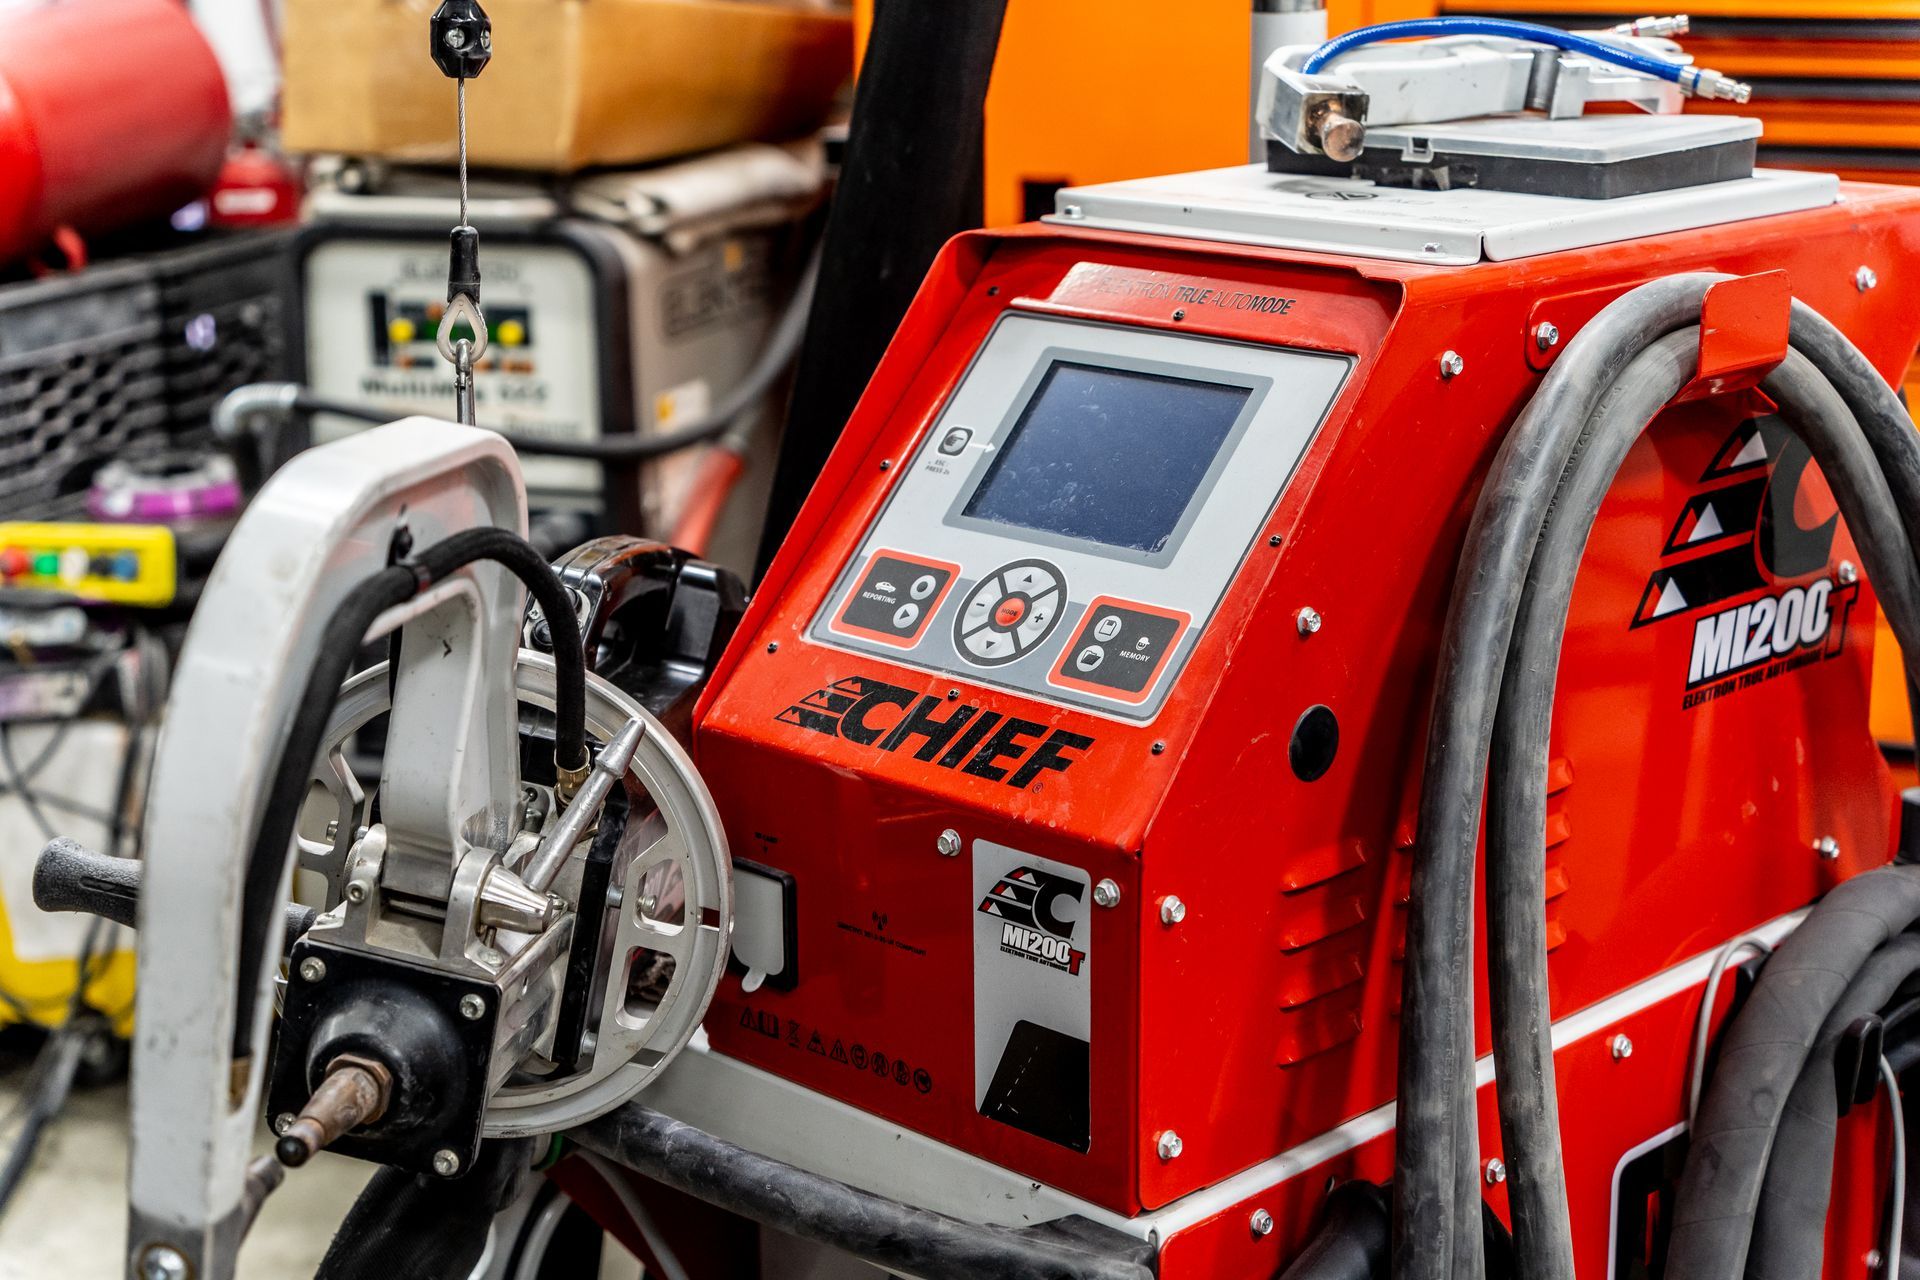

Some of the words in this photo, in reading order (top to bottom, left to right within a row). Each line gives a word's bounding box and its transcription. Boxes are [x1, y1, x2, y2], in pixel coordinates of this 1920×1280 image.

[1174, 286, 1211, 305] TRUE
[1211, 291, 1297, 315] AUTOMODE
[863, 591, 897, 605] REPORTING
[1001, 607, 1018, 617] MODE
[1120, 650, 1151, 663] MEMORY
[1682, 679, 1736, 710] ELEKTRON
[1738, 669, 1764, 691] TRUE
[815, 676, 1096, 789] CHIEF
[1000, 945, 1026, 958] ELEKTRON
[1026, 953, 1040, 963] TRUE
